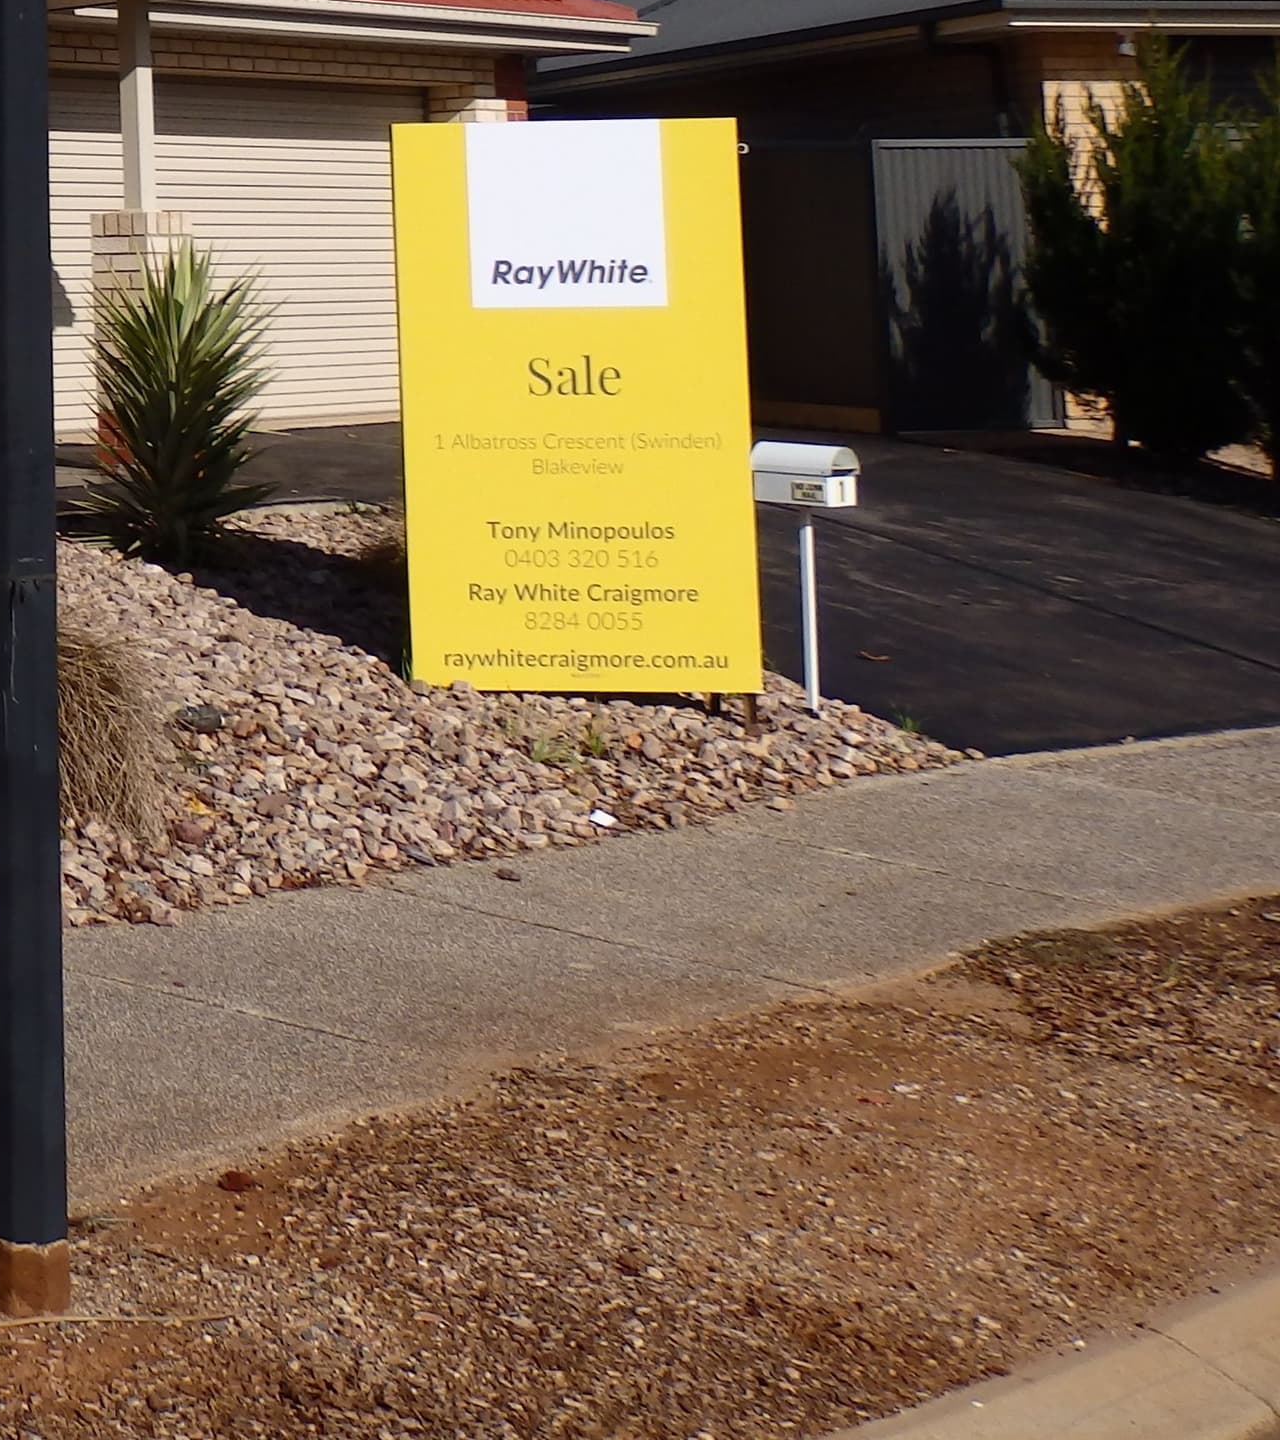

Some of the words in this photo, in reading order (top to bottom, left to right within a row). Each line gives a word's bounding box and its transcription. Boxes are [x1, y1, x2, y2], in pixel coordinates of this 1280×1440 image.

[528, 355, 622, 396] Sale
[435, 434, 445, 450] 1
[452, 432, 537, 450] Albatross
[543, 433, 625, 449] Crescent
[631, 432, 721, 451] (Swinden)
[532, 458, 624, 475] Blakeview
[486, 521, 540, 542] Tony
[548, 521, 674, 543] Minopoulos
[505, 549, 560, 568] 0403
[568, 549, 609, 568] 320
[617, 550, 658, 568] 516
[469, 583, 507, 604] Ray
[514, 584, 580, 602] White
[587, 584, 698, 606] Craigmore
[525, 612, 580, 630] 8284
[587, 612, 643, 631] 0055
[444, 649, 728, 671] raywhitecraigmore.com.au
